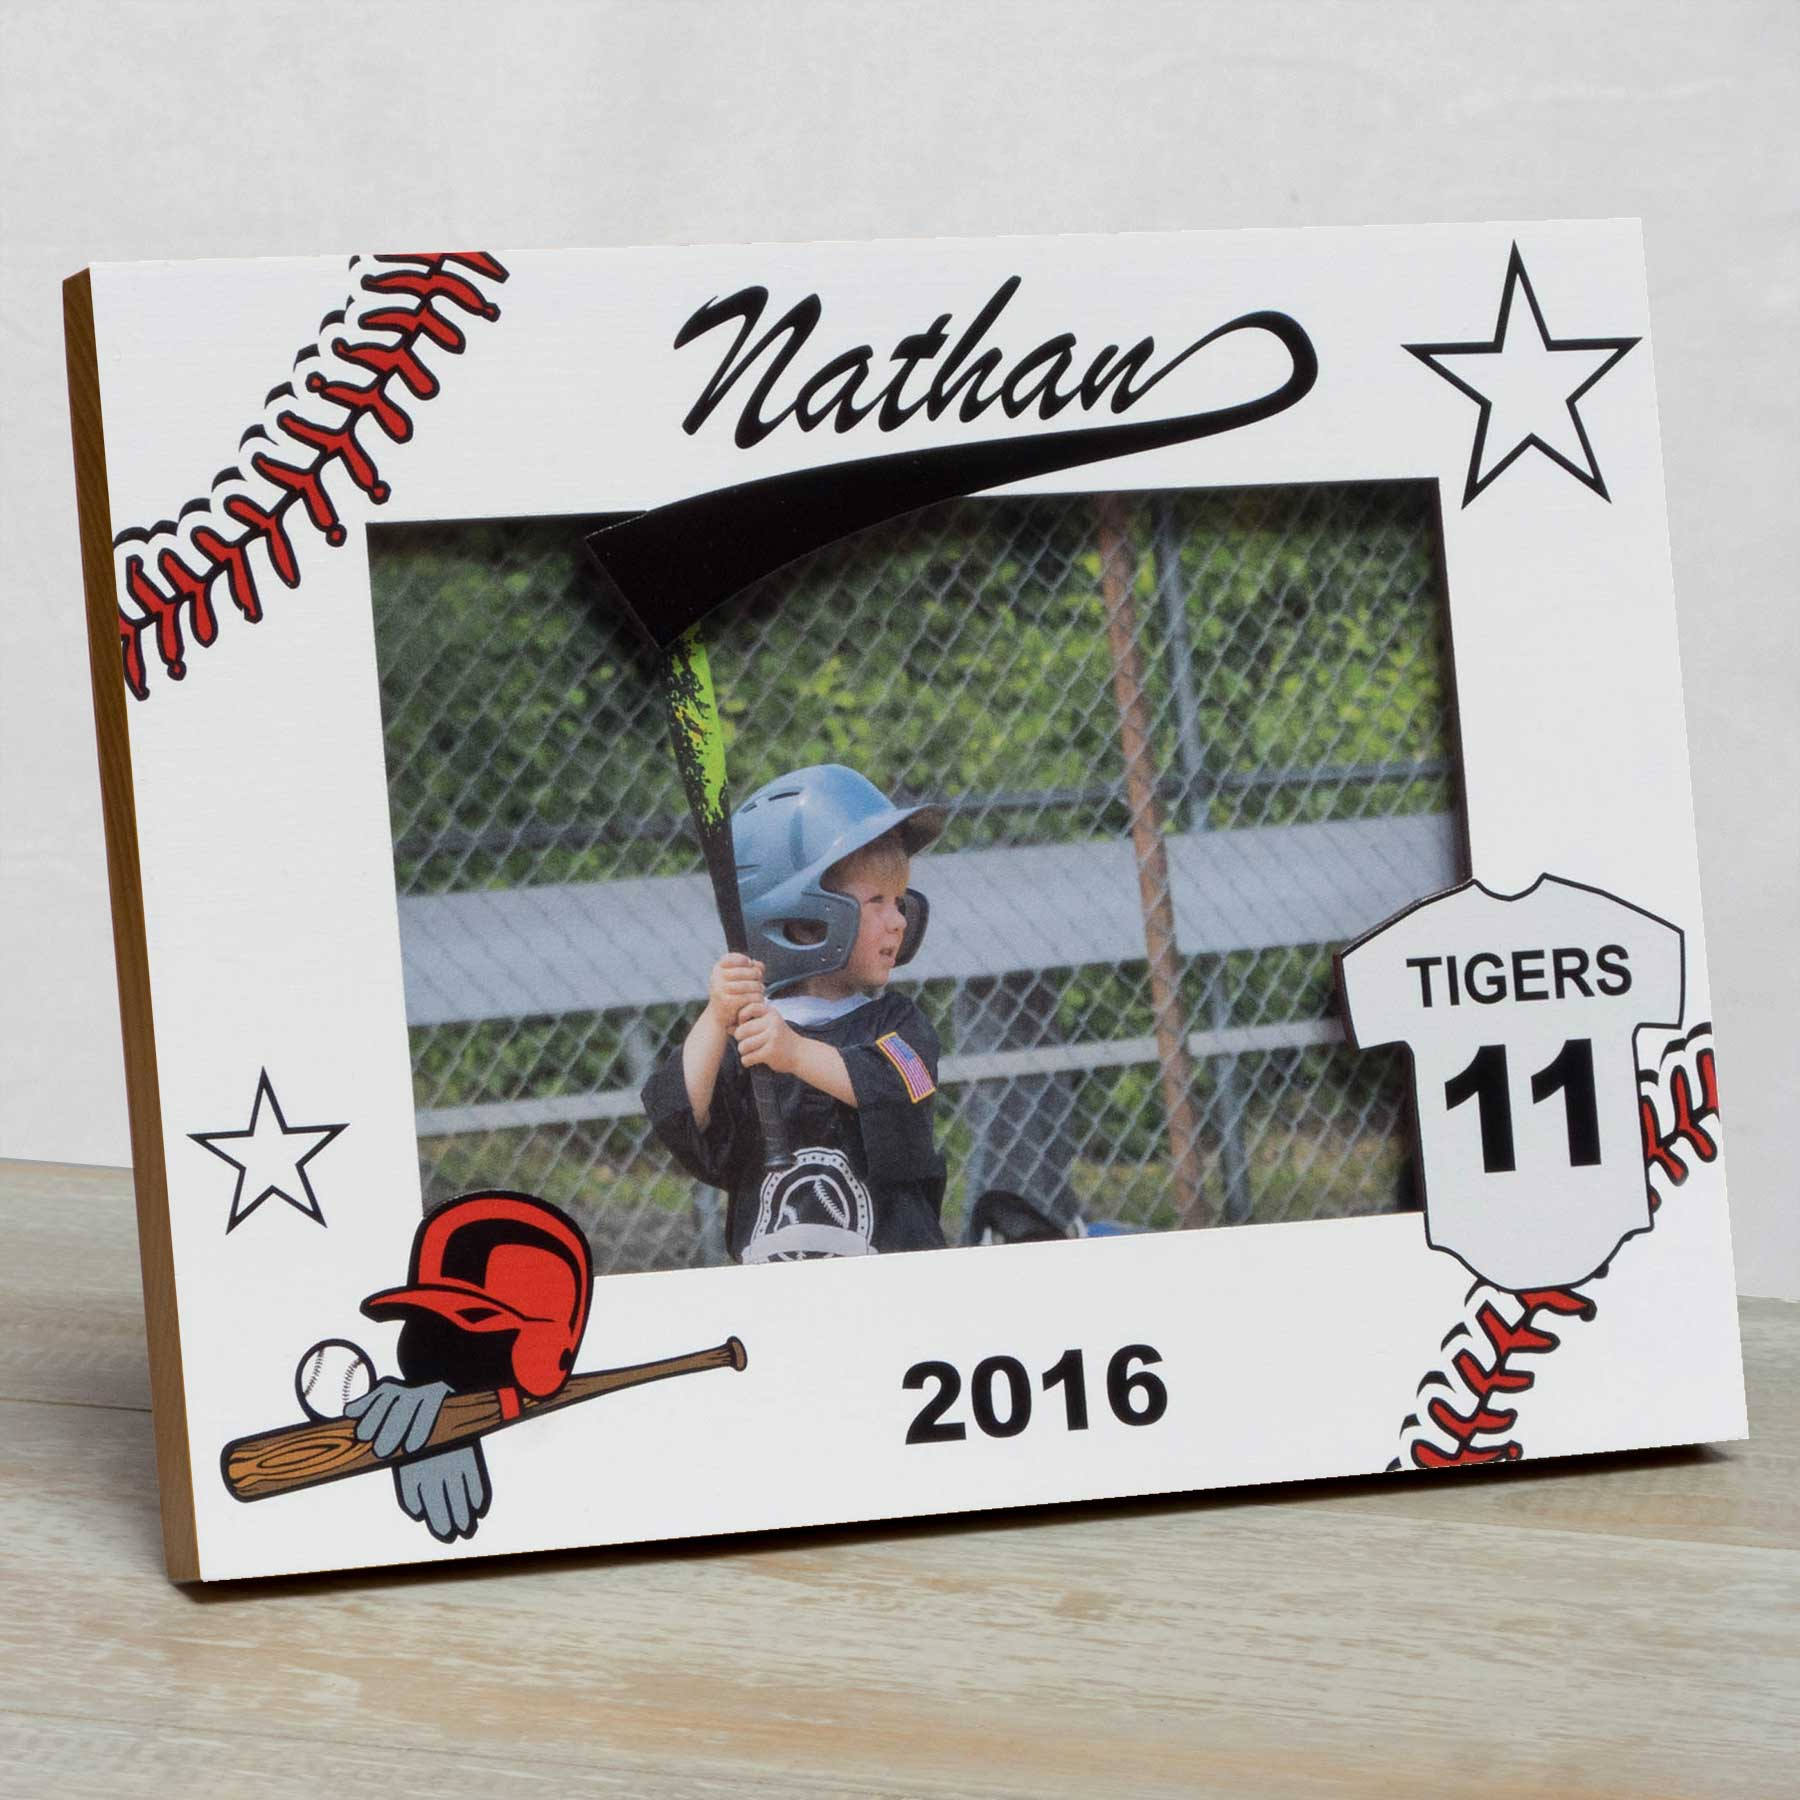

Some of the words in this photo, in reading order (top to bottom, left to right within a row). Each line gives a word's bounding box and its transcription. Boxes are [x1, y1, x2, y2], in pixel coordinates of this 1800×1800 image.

[673, 275, 1157, 450] Nathan
[1406, 944, 1633, 1008] TIGERS
[1444, 1038, 1602, 1174] 11
[902, 1344, 1168, 1445] 2016
